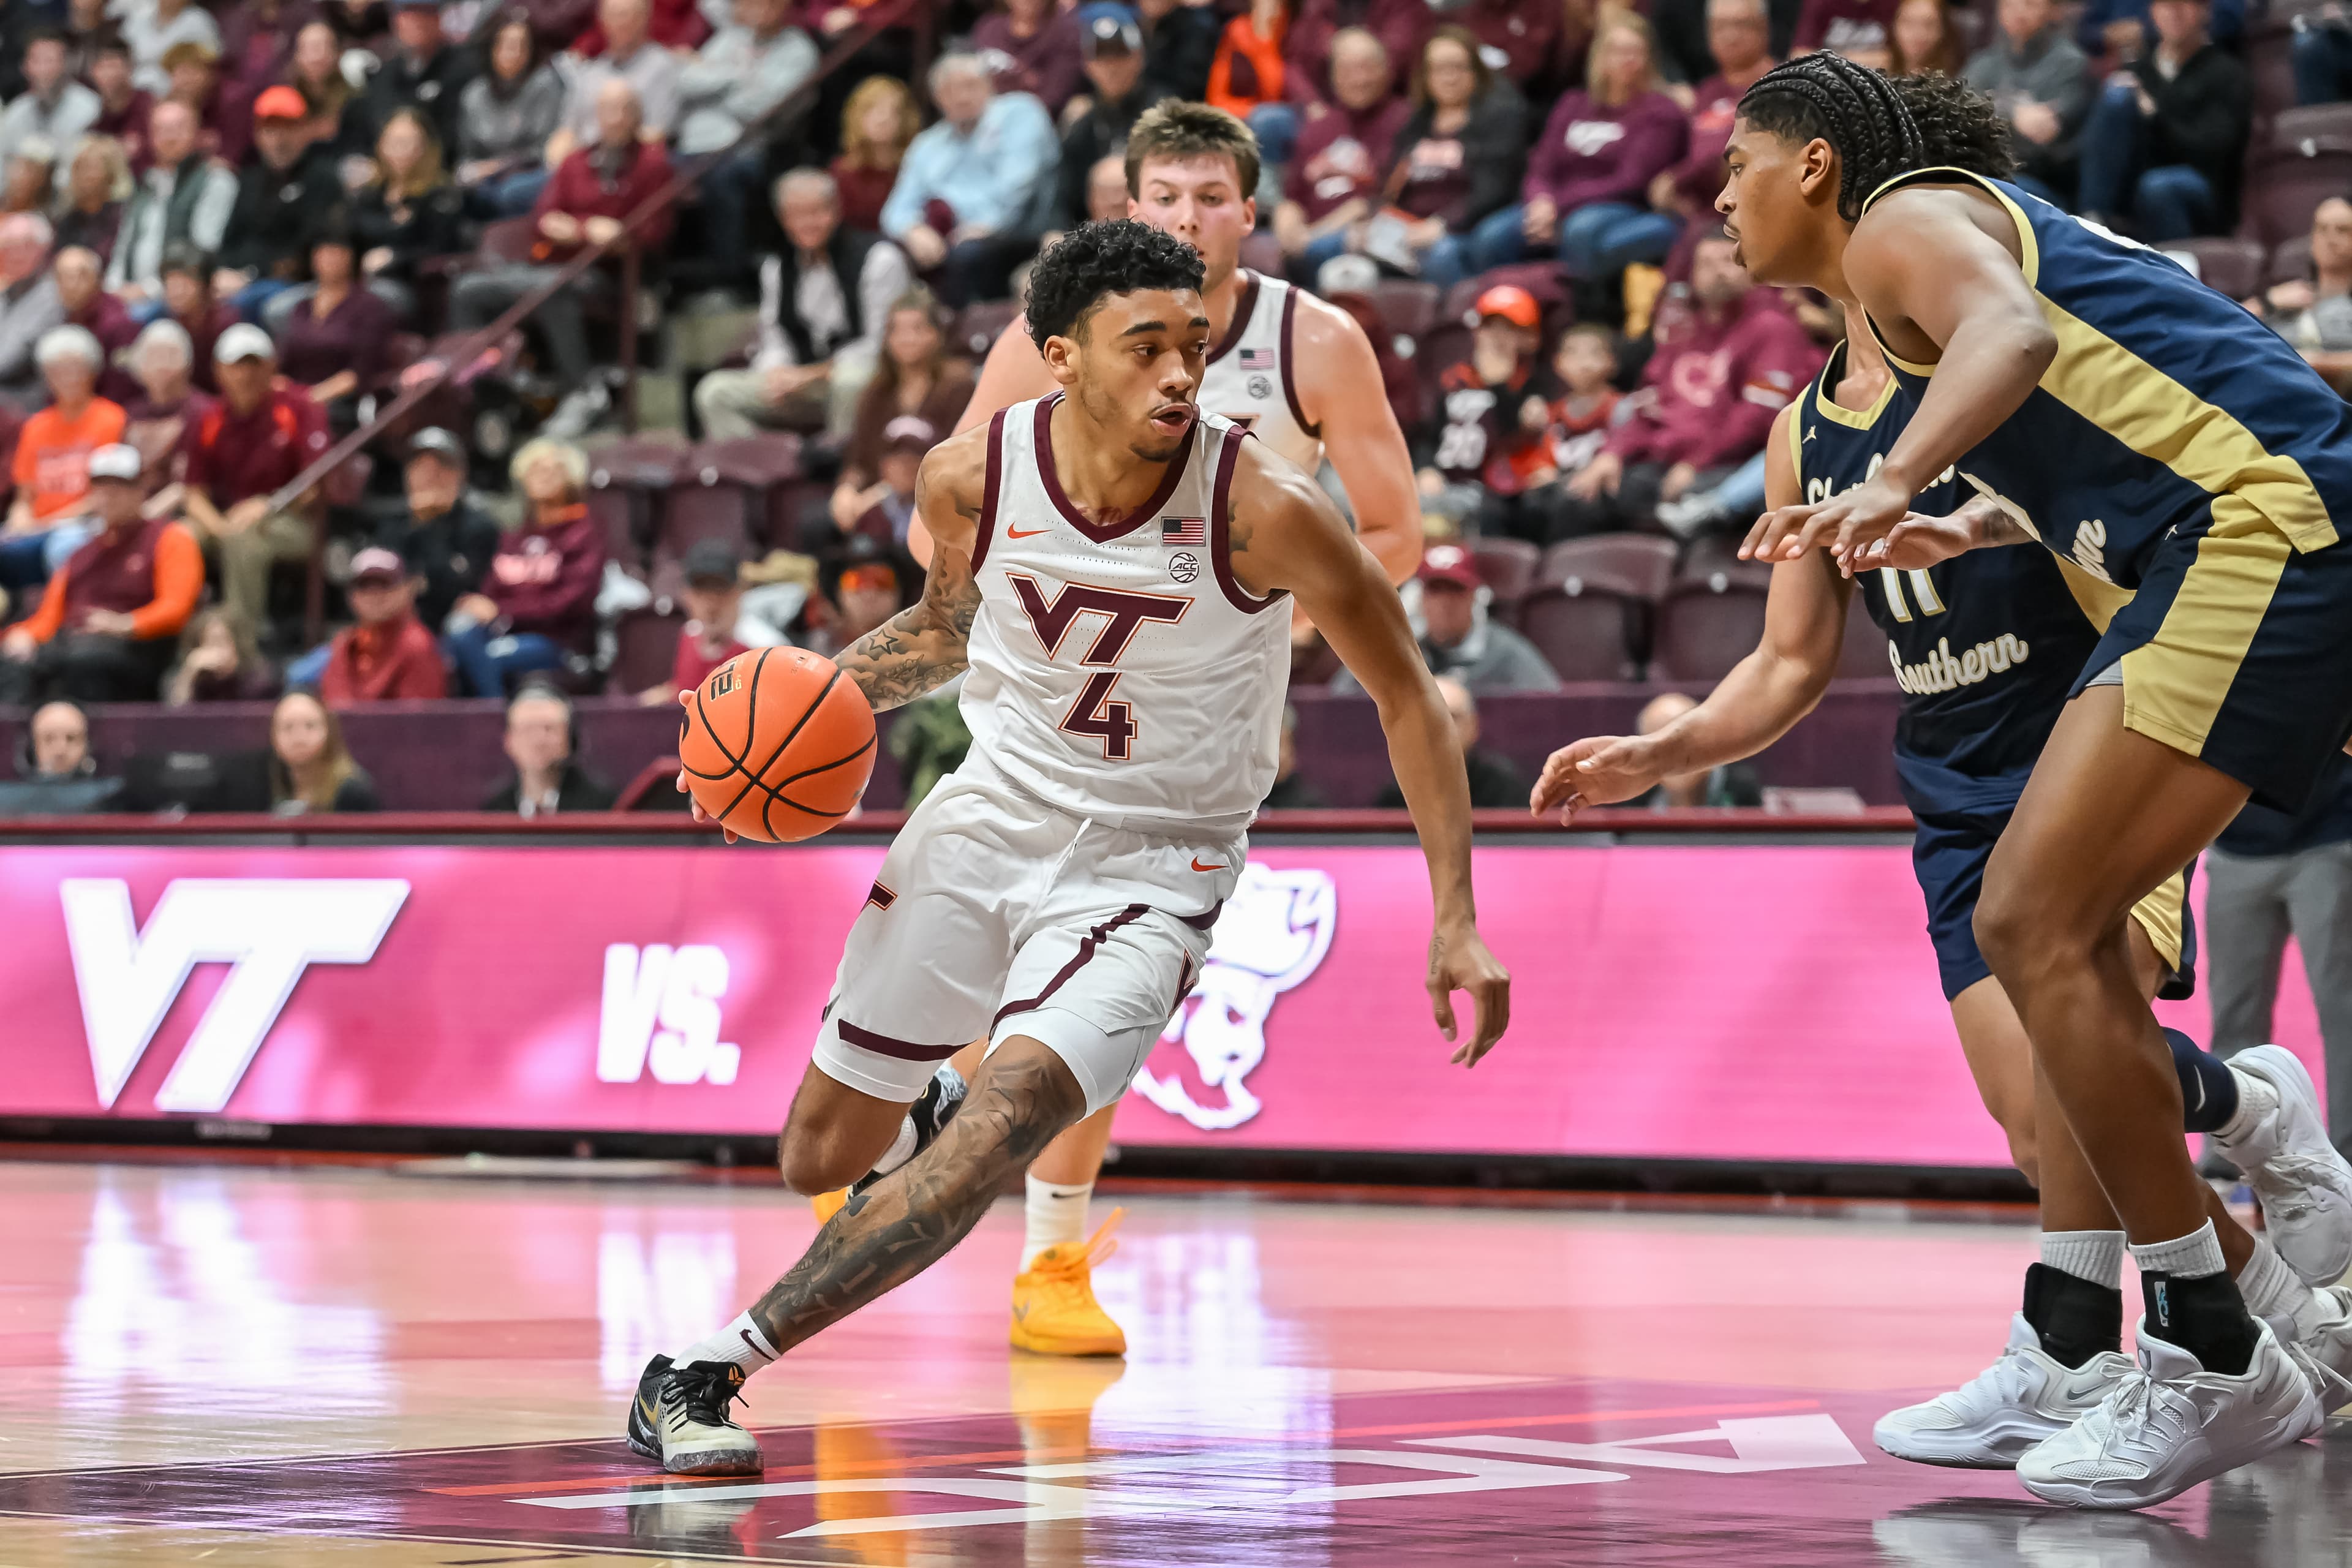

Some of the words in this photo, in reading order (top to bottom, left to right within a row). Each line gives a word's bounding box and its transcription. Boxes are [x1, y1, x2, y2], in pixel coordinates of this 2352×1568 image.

[1005, 572, 1196, 666] VT
[1889, 633, 2029, 695] Southern
[1058, 672, 1138, 760] 4
[59, 878, 412, 1113] VT
[597, 943, 741, 1085] VS.
